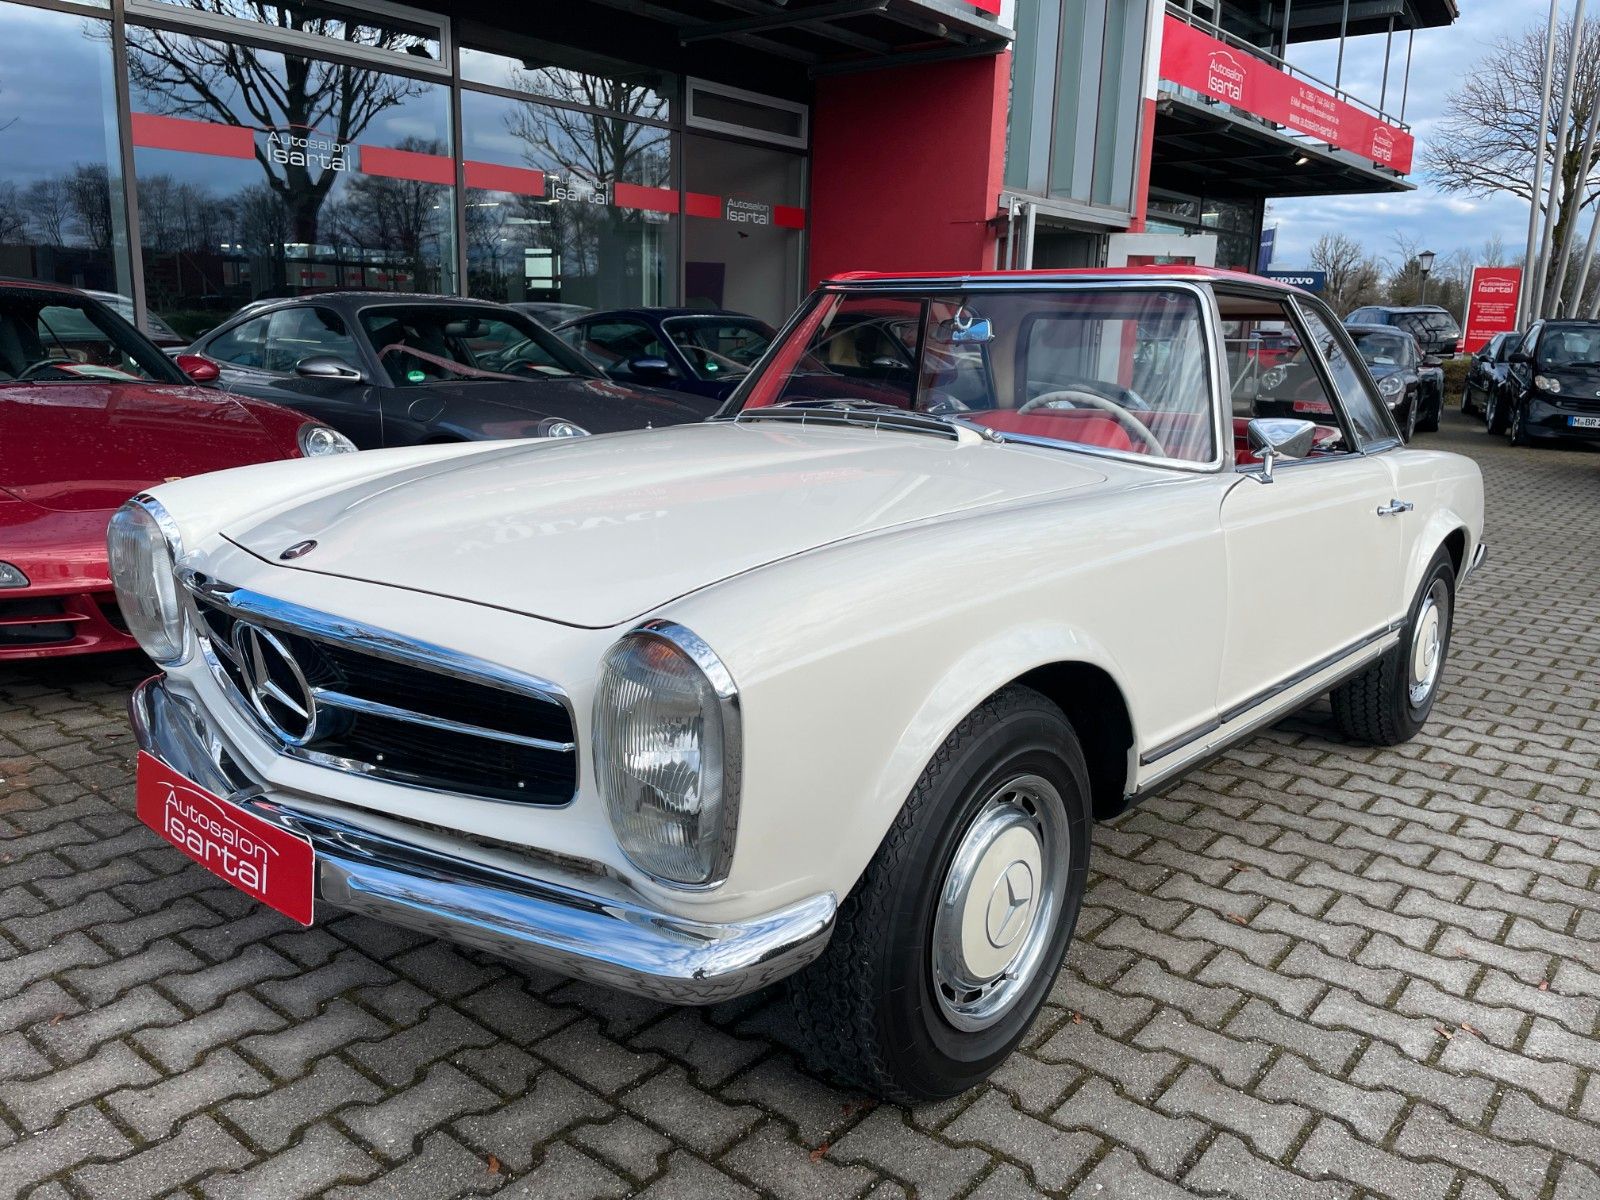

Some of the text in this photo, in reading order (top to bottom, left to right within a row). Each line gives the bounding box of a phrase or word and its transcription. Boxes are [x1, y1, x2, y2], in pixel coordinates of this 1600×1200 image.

[1209, 58, 1244, 83] Autosalon
[1208, 70, 1243, 101] Isartal
[267, 131, 350, 153] Autosalon
[1372, 141, 1393, 162] Isartal
[266, 143, 351, 172] Isartal
[552, 177, 609, 190] Autoaon
[726, 206, 769, 225] Isartal
[727, 198, 769, 211] Autosalon
[1478, 285, 1513, 293] Isartal
[166, 790, 268, 863] Autosalon
[164, 804, 267, 895] Isartal
